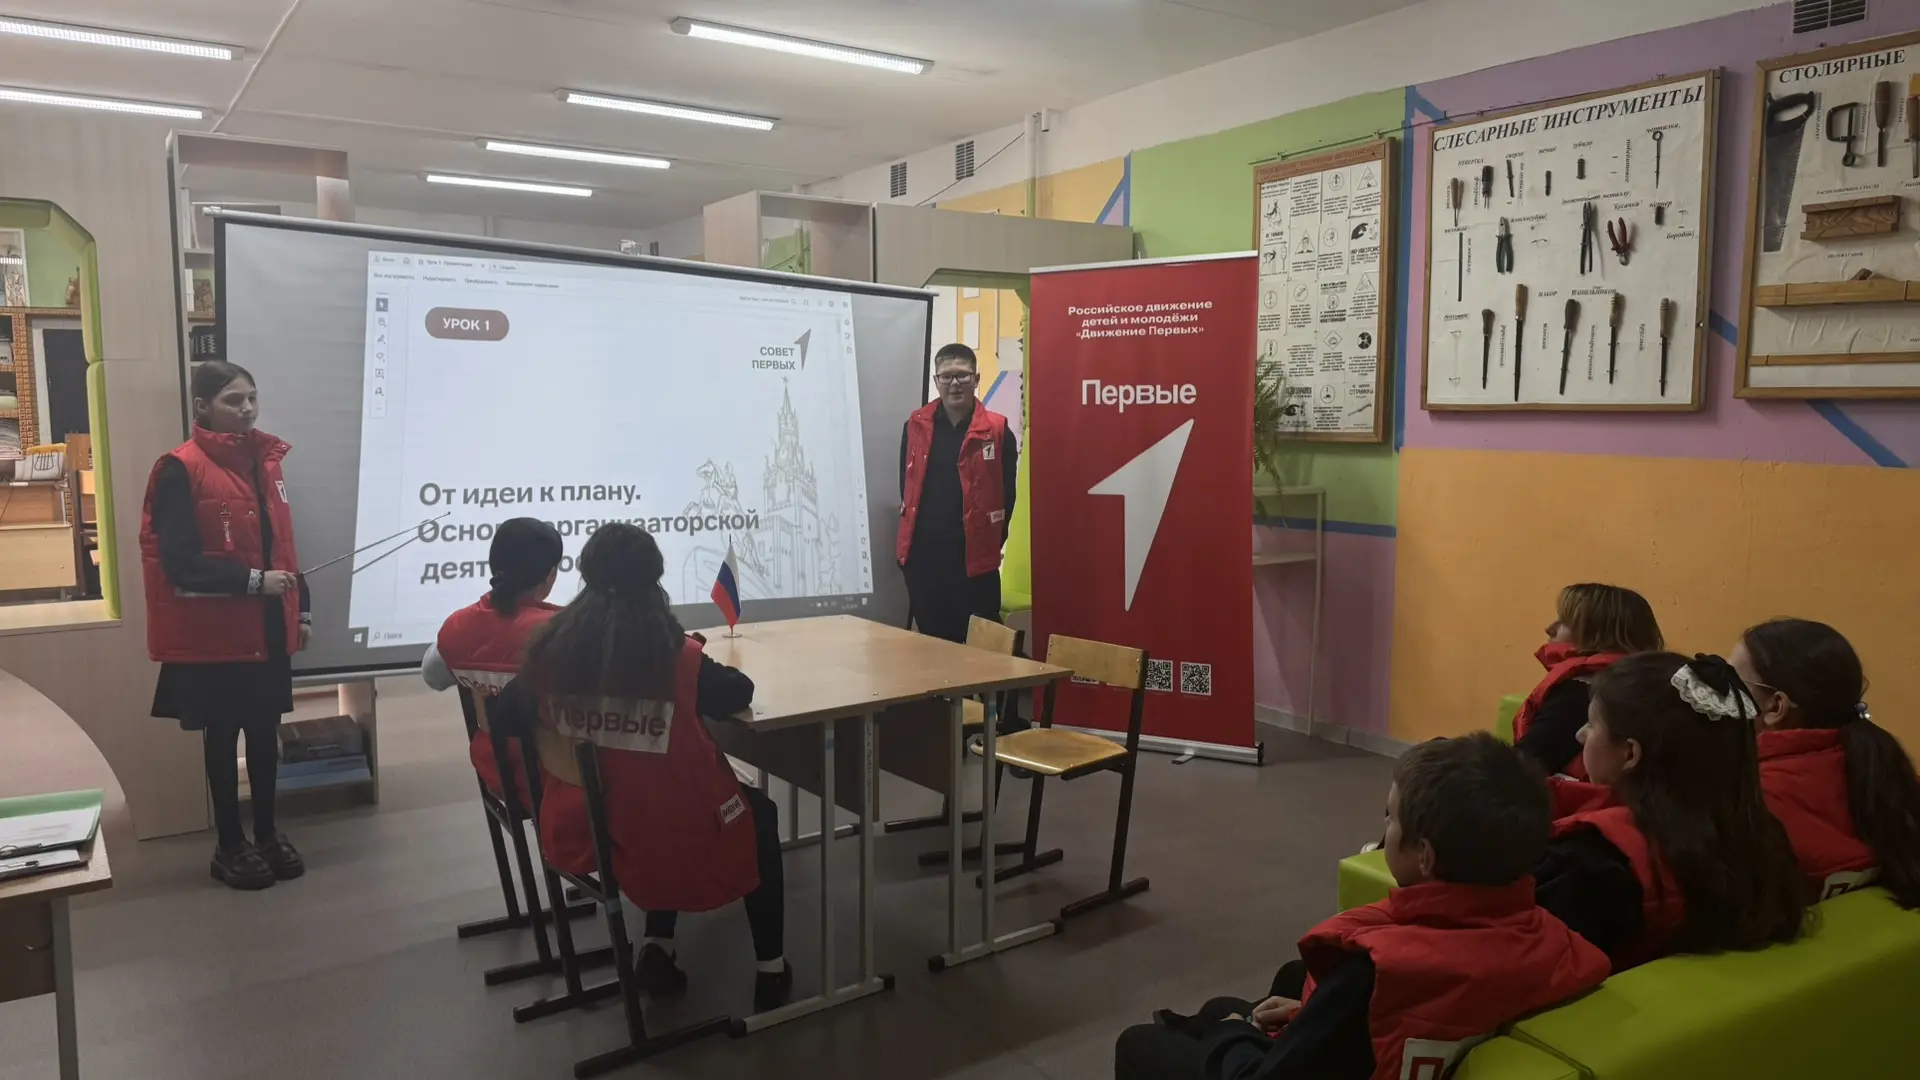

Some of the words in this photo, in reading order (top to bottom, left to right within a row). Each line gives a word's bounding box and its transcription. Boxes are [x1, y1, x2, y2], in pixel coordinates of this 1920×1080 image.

[1779, 49, 1905, 84] СТОЛЯРНЫЕ
[1434, 116, 1538, 151] СЛЕСАРНЫЕ
[1543, 84, 1703, 131] ИНСТРУМЕНТЫ
[1068, 303, 1143, 316] Российское
[1145, 300, 1213, 313] движение
[443, 317, 480, 331] УРОК
[484, 320, 490, 331] 1
[1081, 316, 1118, 328] детей
[1130, 312, 1199, 325] молодёжи
[760, 346, 795, 357] СОВЕТ
[752, 359, 796, 370] ПЕРВЫХ
[1081, 379, 1197, 413] Первые
[419, 482, 456, 506] От
[463, 485, 533, 508] идеи
[540, 485, 555, 502] к
[561, 484, 641, 506] плану.
[418, 518, 501, 543] Осно
